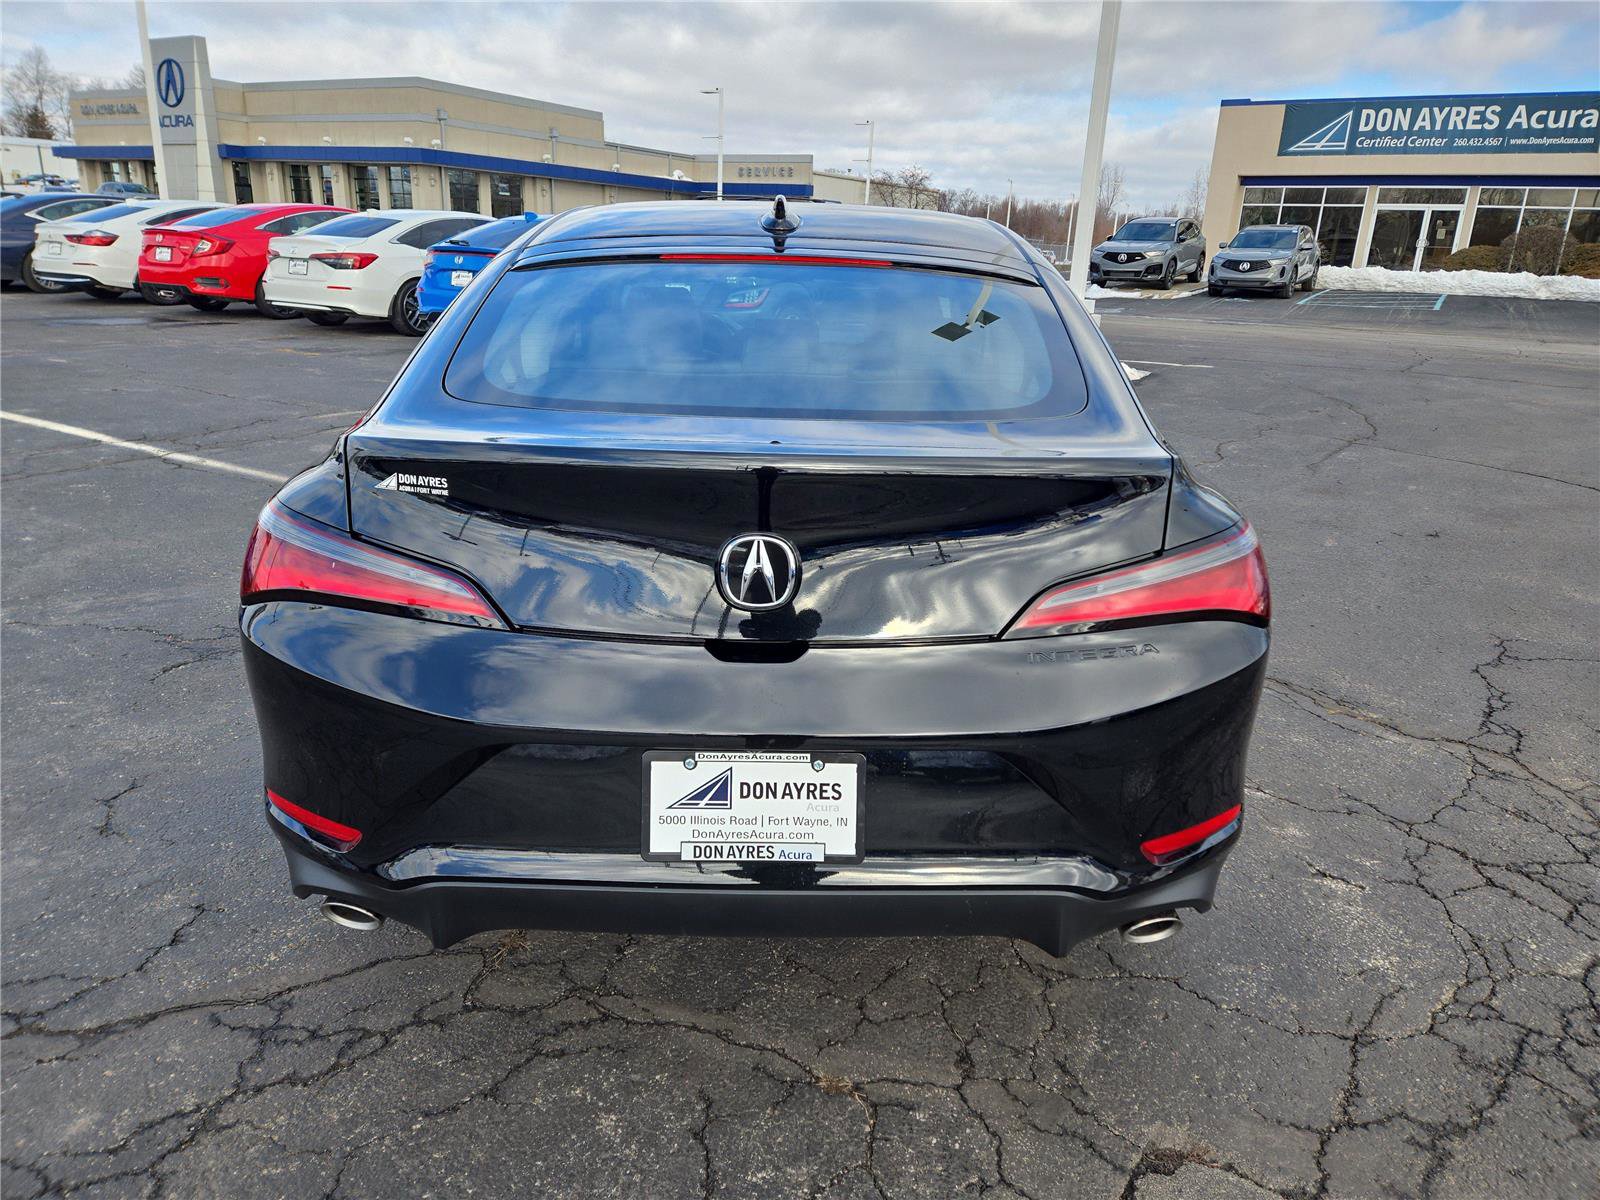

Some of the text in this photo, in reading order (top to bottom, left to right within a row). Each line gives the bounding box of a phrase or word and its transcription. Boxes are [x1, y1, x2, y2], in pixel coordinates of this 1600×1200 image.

[1358, 104, 1598, 132] DON AYRES Acura
[1356, 135, 1595, 148] Certified Center 260.432.4567 www.DonAyresAcura.com
[738, 167, 794, 177] SERVICE
[399, 474, 448, 488] DON AYRES
[431, 488, 449, 496] WAYNE
[1026, 643, 1160, 664] INTEGRA
[698, 753, 809, 762] DonAyresAcura.com
[739, 781, 842, 801] DON AYRES
[806, 803, 840, 813] Acura
[658, 815, 849, 829] 5000 Illinois Road Fort Wayne, IN
[692, 830, 814, 841] DonAyresAcura.com
[693, 845, 813, 860] DON AYRES Acura
